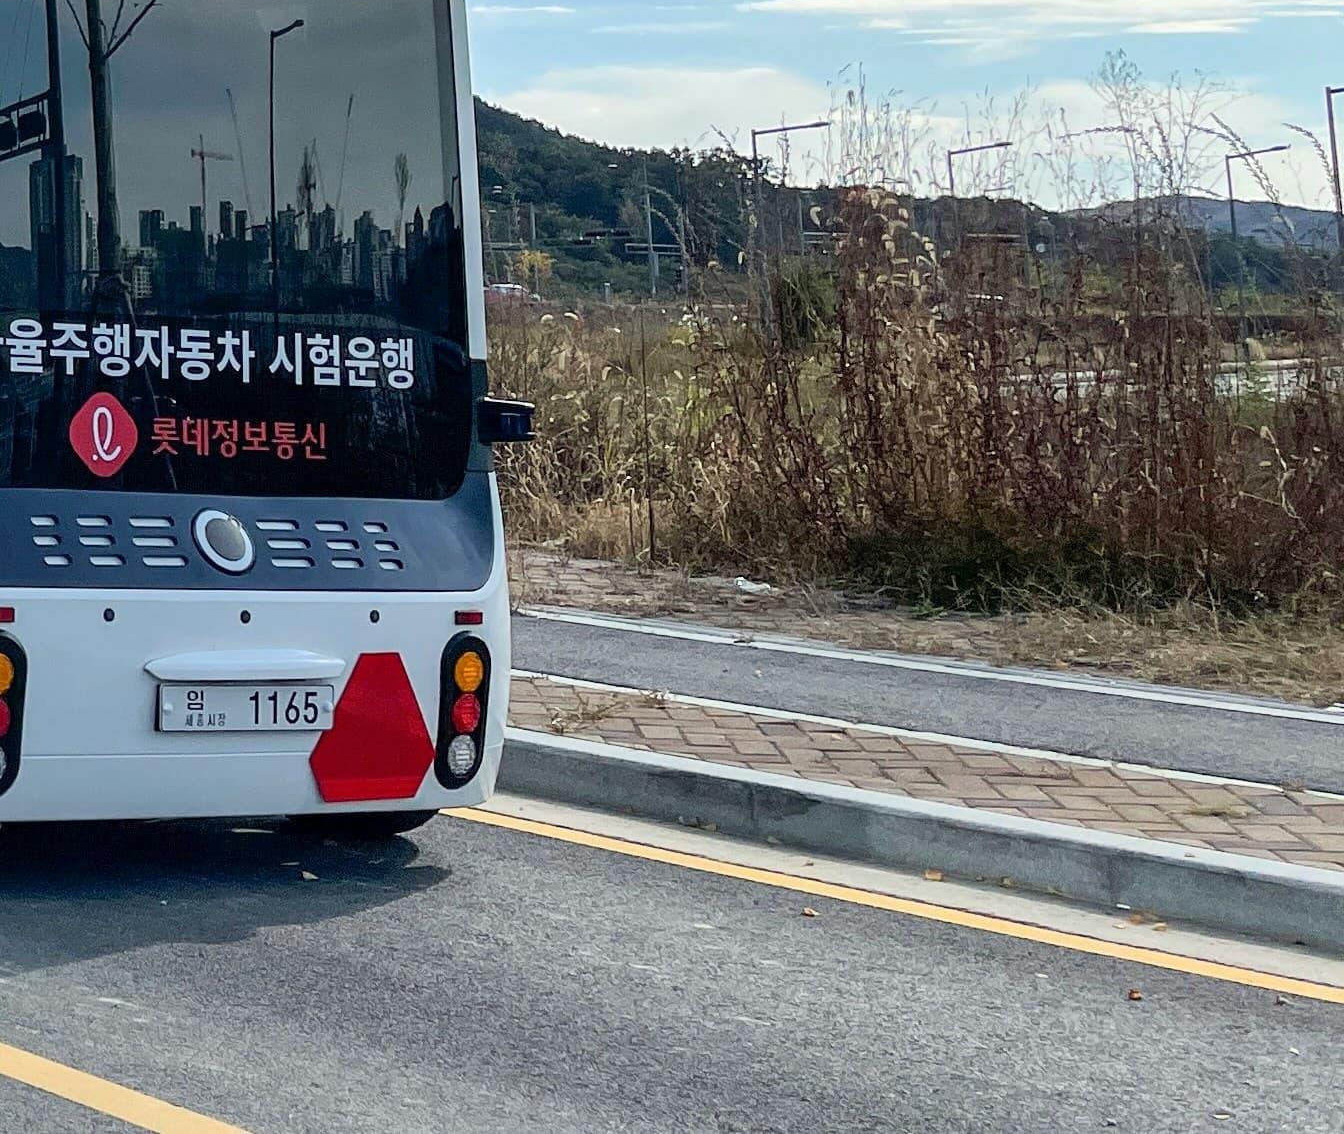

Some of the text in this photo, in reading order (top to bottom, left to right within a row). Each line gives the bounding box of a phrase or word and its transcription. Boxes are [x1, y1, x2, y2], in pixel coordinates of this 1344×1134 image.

[268, 331, 415, 390] 시험운행
[150, 415, 328, 460] 롯데정보통신
[186, 689, 319, 725] 임 1165
